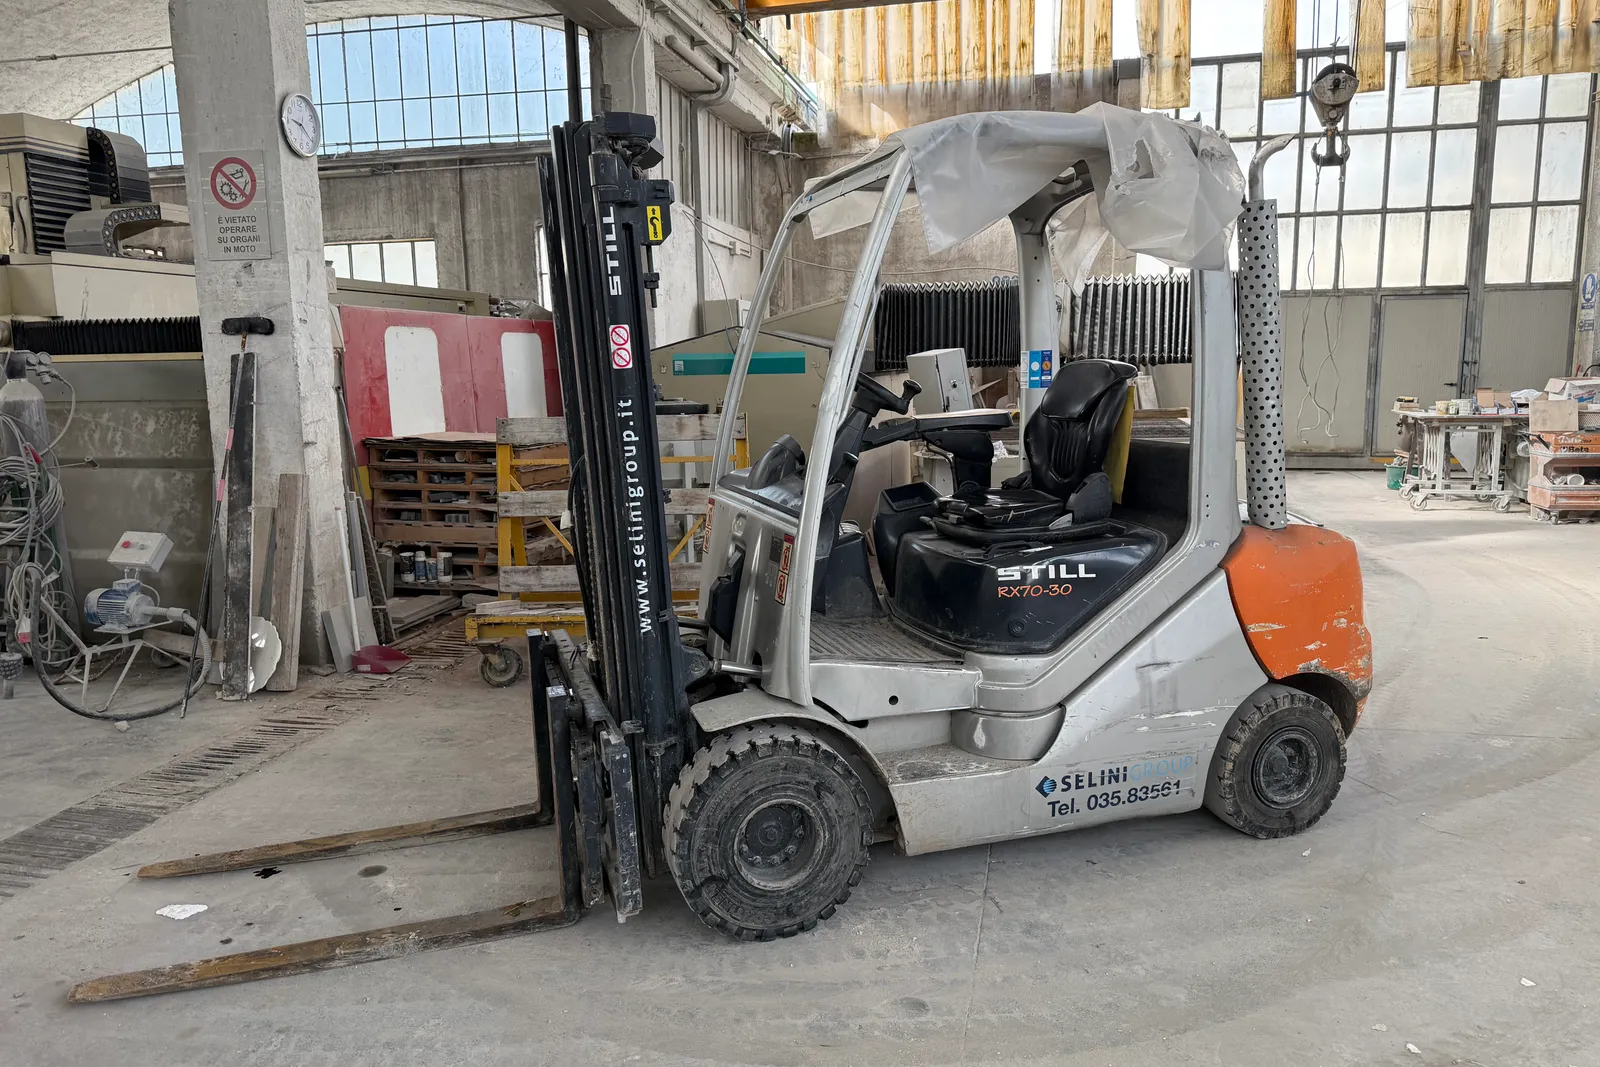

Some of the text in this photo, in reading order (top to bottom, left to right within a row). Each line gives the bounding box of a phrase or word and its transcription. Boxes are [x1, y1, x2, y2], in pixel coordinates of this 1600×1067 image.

[217, 215, 257, 225] È VIETATO
[219, 225, 257, 234] OPERARE
[217, 235, 260, 244] SU ORGANI
[233, 245, 256, 253] MOTO
[602, 206, 622, 296] STILL
[618, 398, 652, 634] www.selinigroup.it
[997, 563, 1096, 581] STILL
[997, 583, 1073, 598] RX70-30
[1047, 779, 1181, 818] Tel. 035.83561
